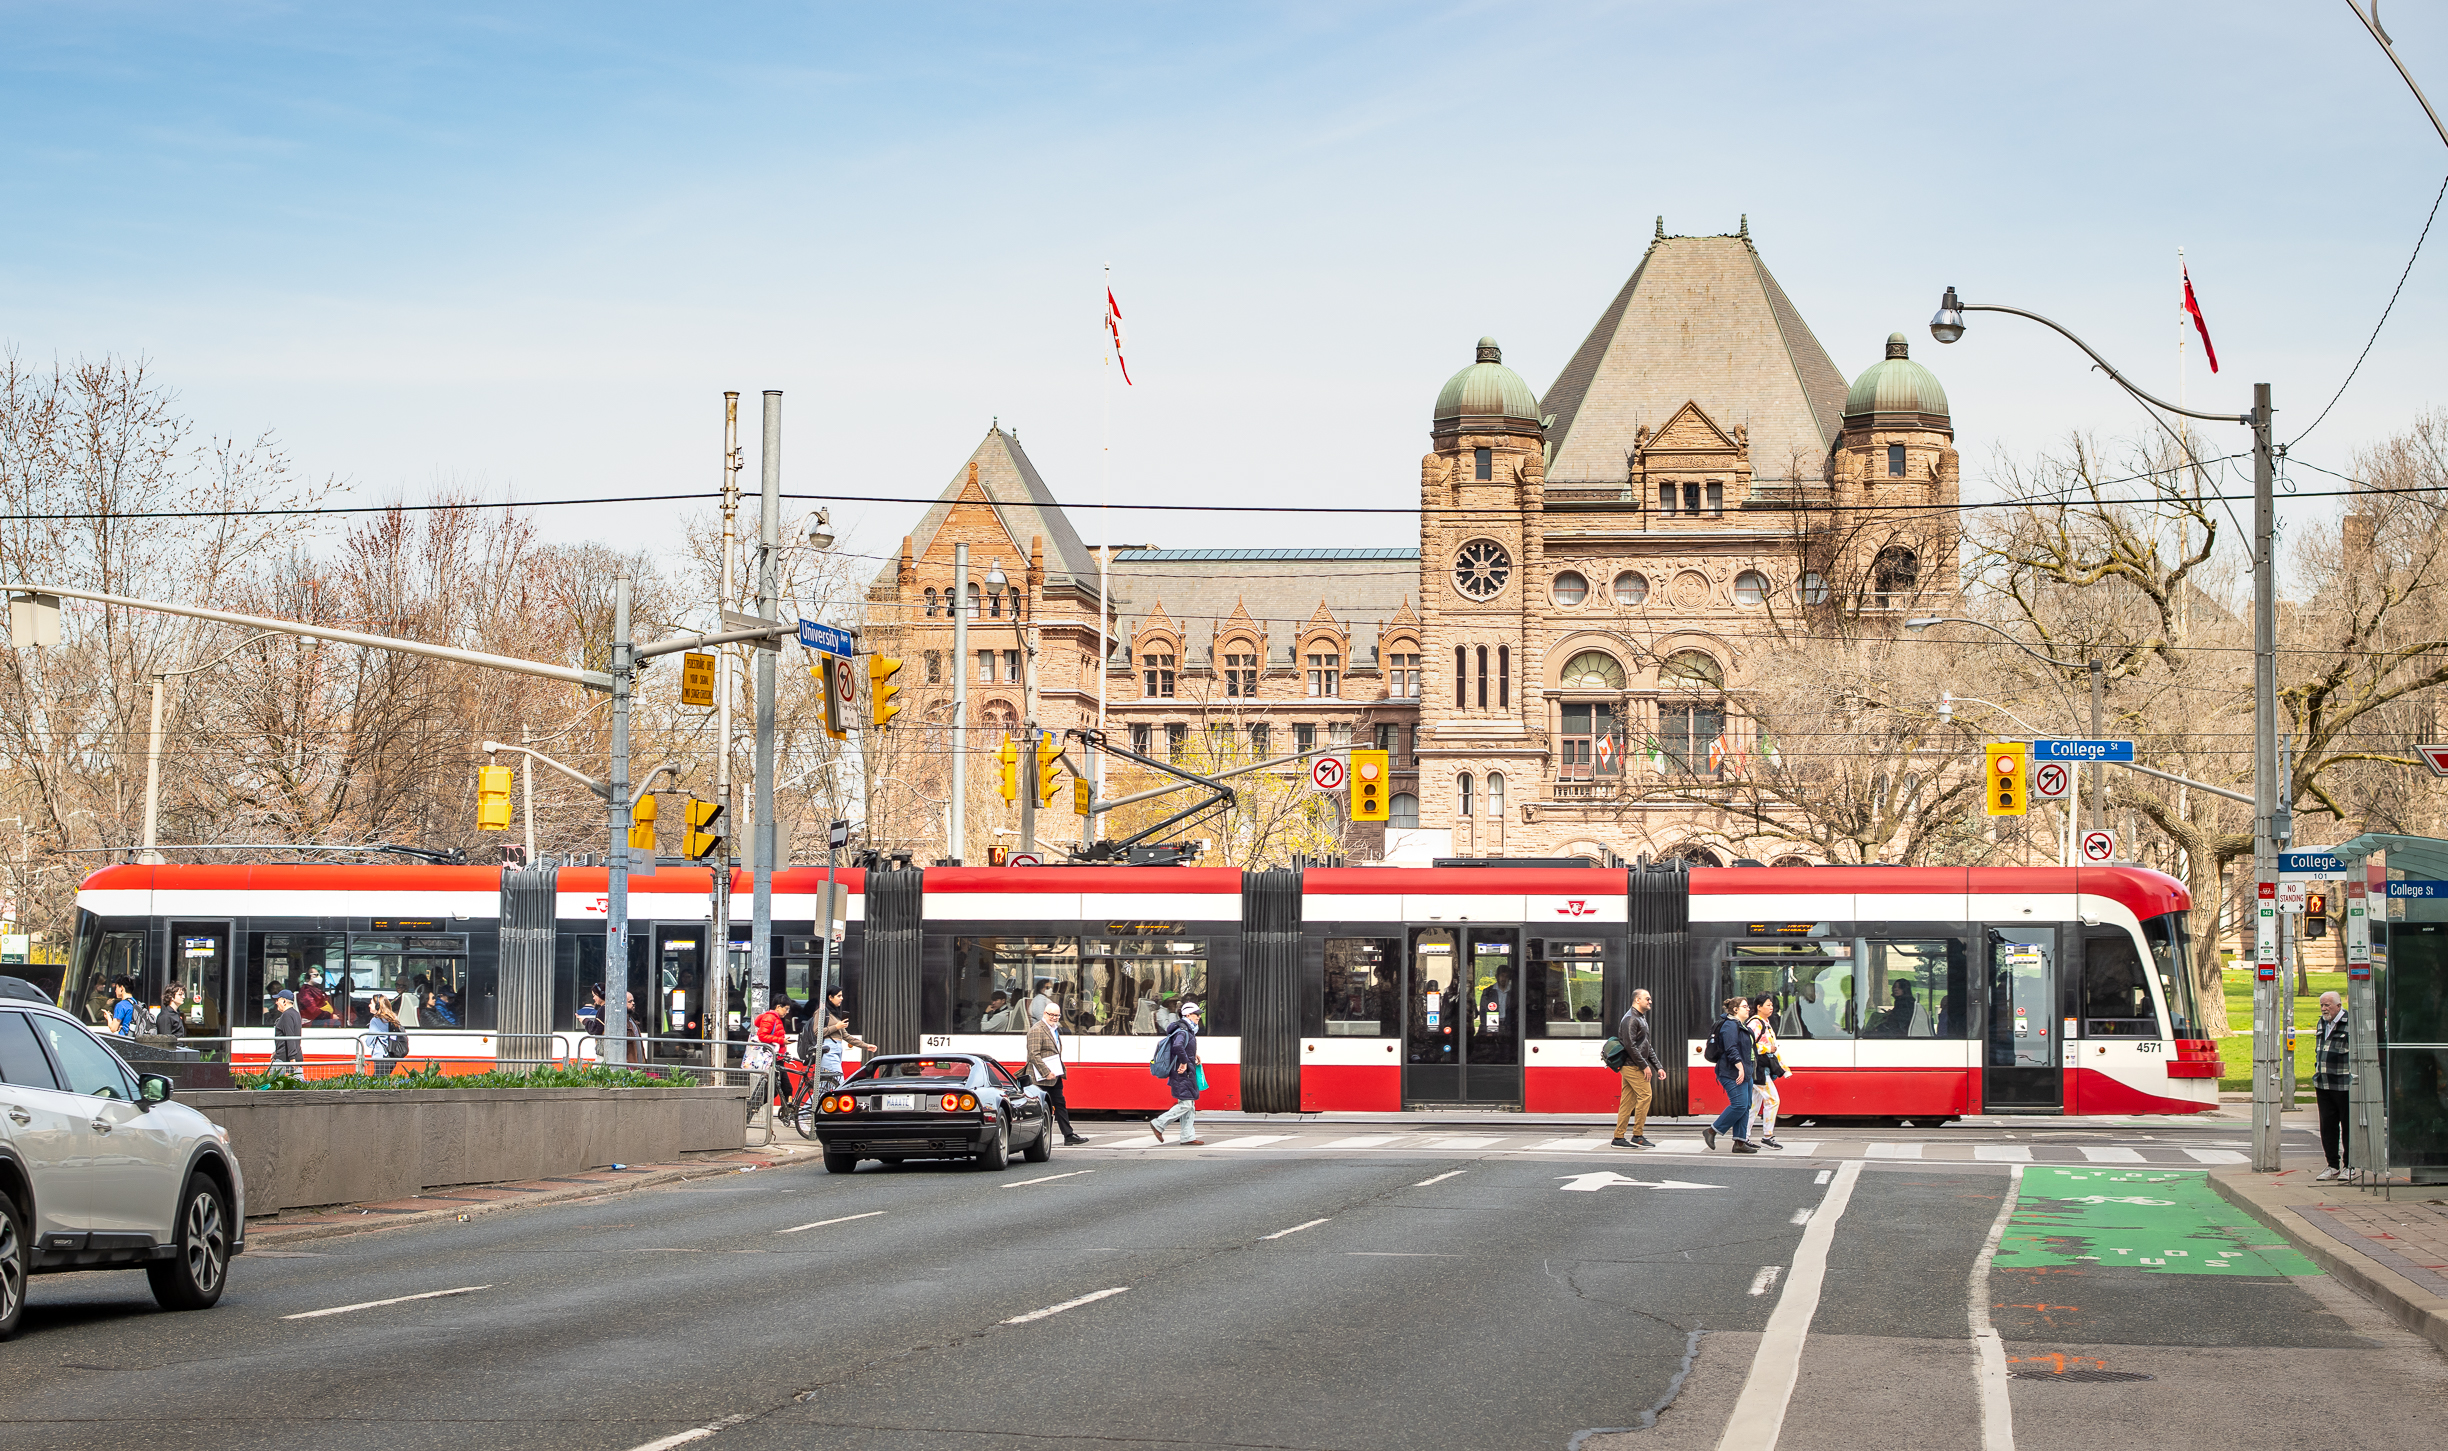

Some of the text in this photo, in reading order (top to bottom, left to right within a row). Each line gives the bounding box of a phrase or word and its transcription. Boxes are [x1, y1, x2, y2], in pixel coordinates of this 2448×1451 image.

[801, 621, 849, 652] University Ave
[2051, 742, 2118, 760] College St
[2290, 855, 2336, 870] College
[2287, 884, 2296, 892] NO
[2390, 883, 2424, 898] College
[2425, 885, 2434, 896] St
[2280, 894, 2304, 902] STANDING
[927, 1037, 950, 1046] 4571
[2136, 1042, 2162, 1053] 4571
